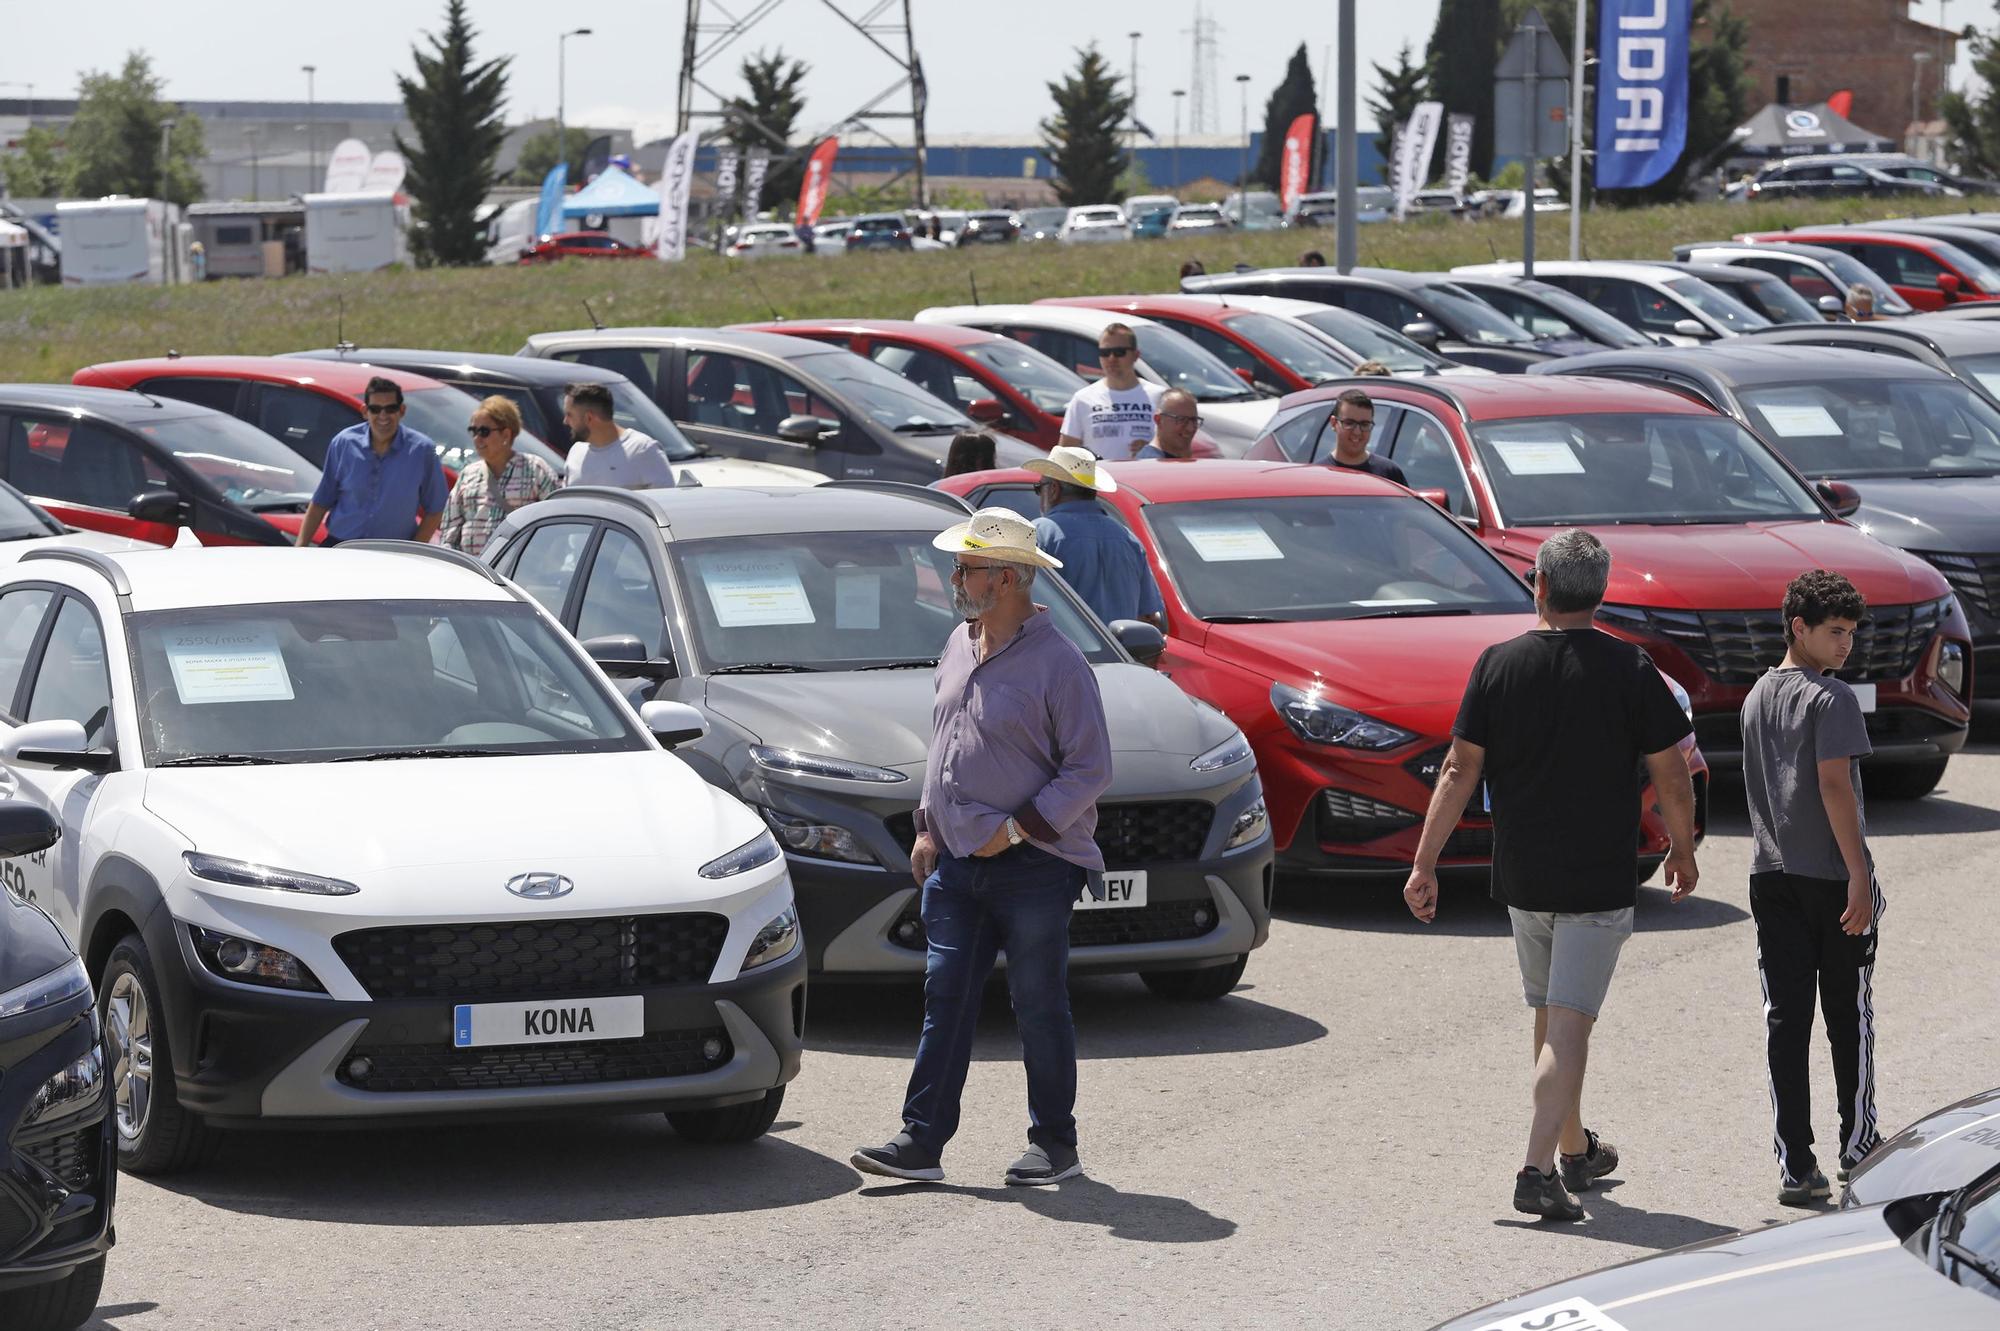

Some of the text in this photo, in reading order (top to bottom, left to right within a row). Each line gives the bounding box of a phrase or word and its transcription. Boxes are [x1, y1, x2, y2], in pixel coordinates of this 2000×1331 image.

[1092, 403, 1152, 412] G-STAR
[525, 1007, 594, 1035] KONA
[460, 1029, 468, 1039] E
